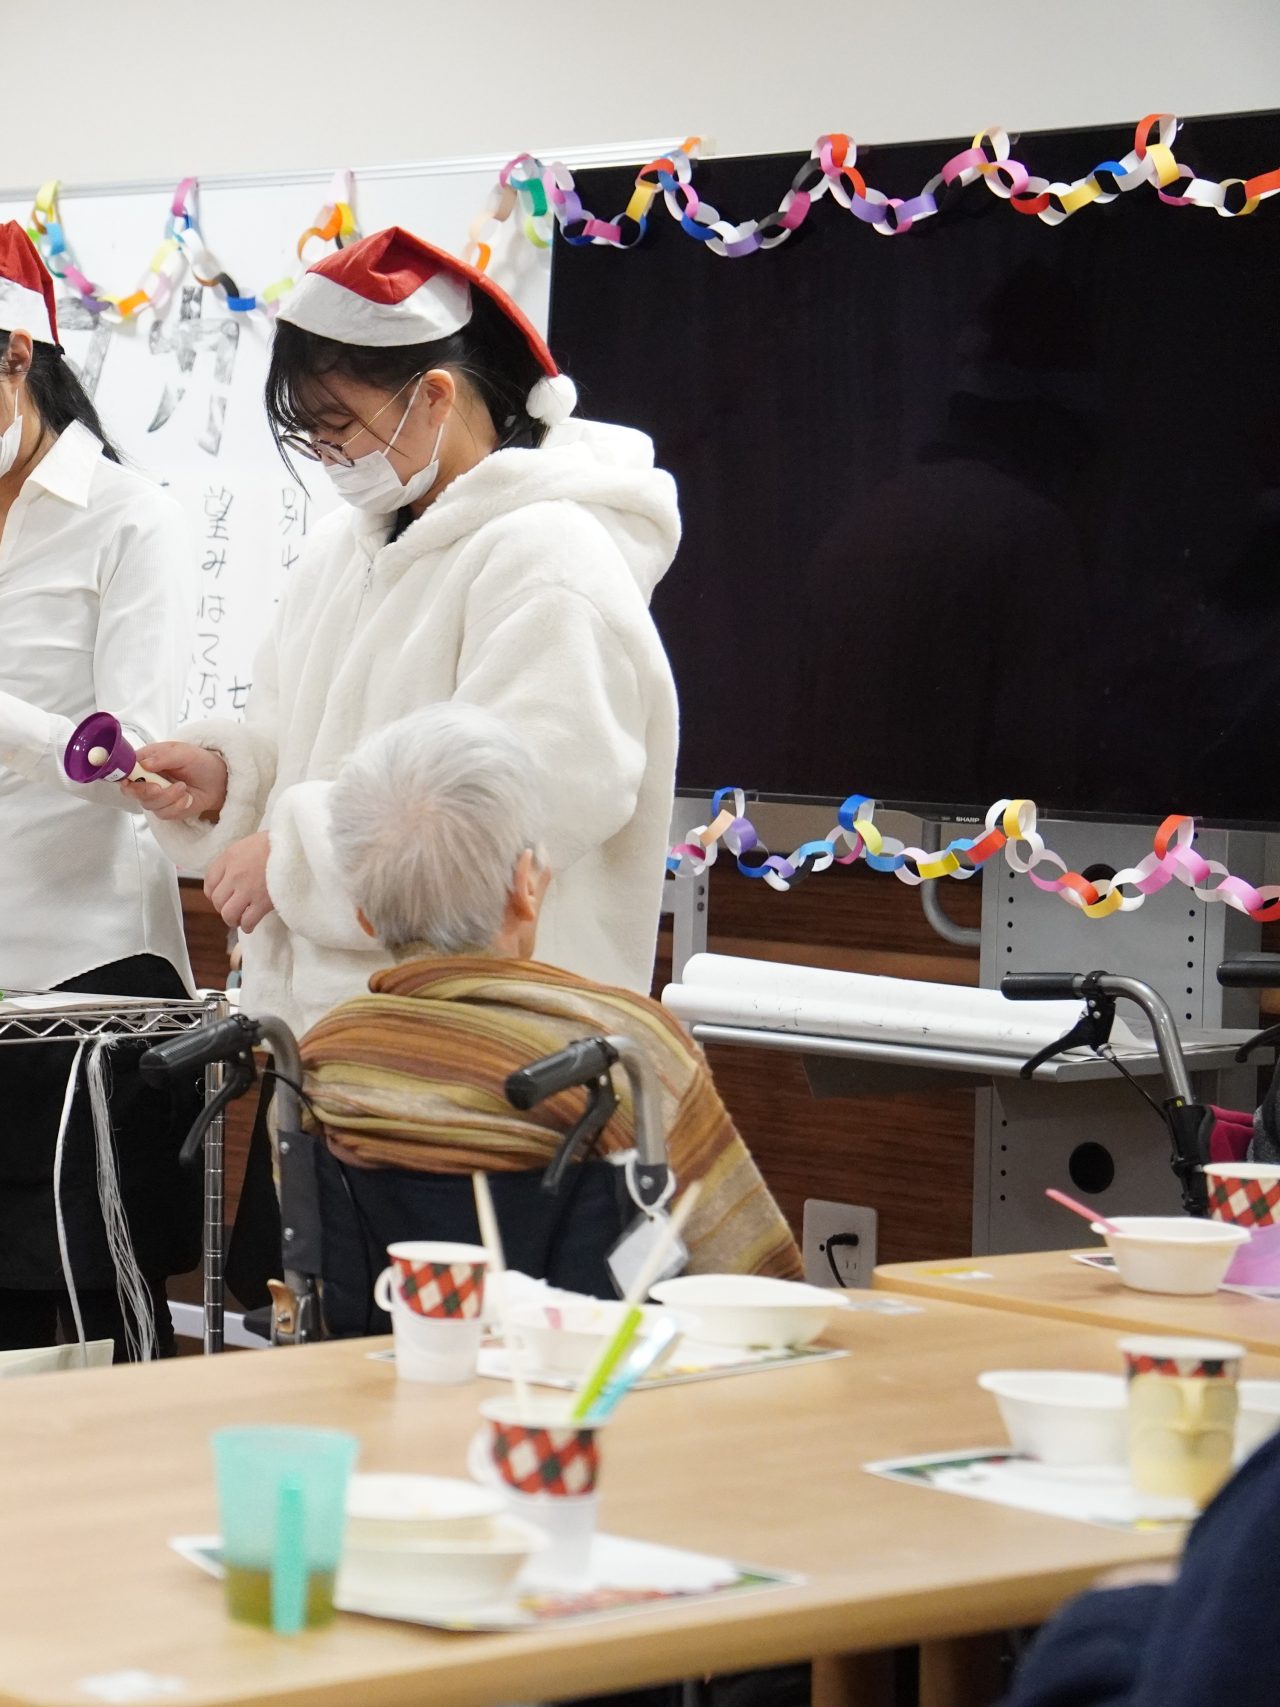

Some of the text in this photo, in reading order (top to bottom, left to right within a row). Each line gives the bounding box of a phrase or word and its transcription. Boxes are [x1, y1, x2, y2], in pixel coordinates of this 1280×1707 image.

[196, 485, 234, 719] 望みはてな
